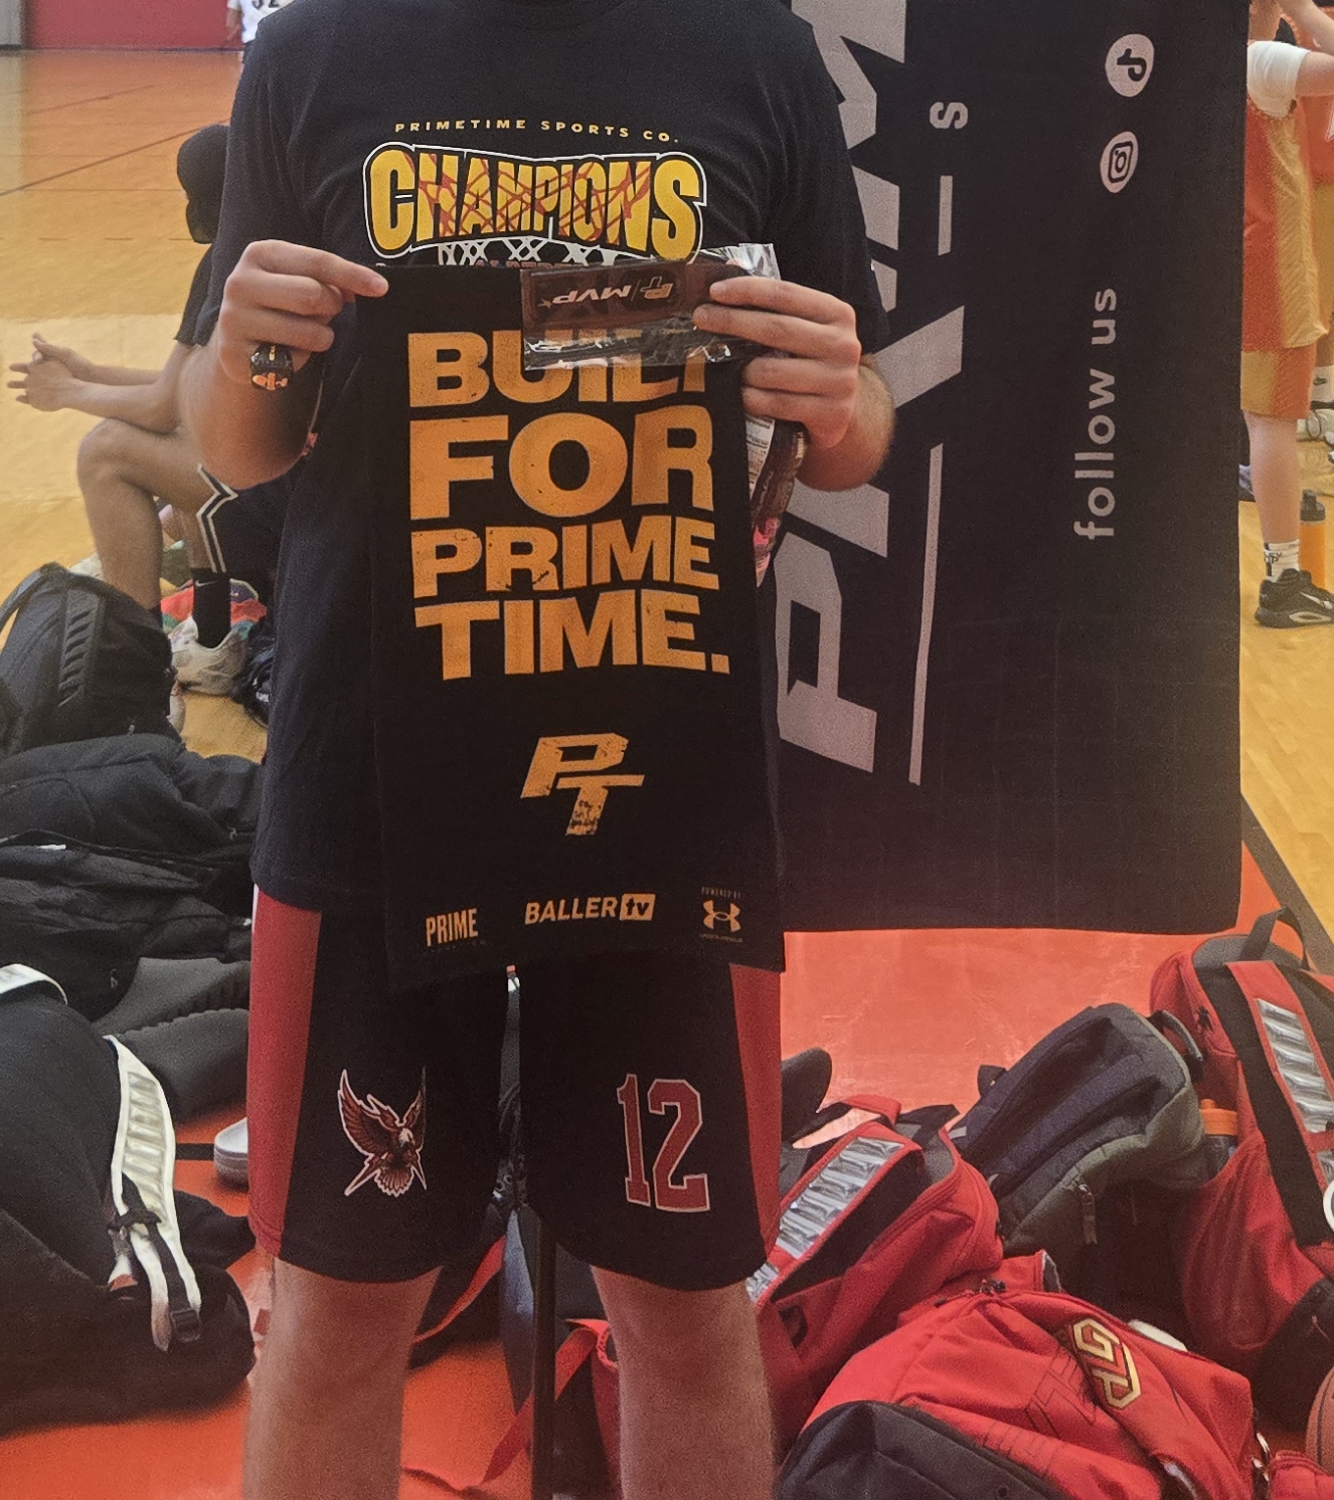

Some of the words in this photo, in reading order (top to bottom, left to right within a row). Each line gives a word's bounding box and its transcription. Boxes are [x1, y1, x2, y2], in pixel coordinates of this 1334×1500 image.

[395, 119, 526, 133] PRIMETIME
[540, 120, 629, 138] SPORTS
[642, 130, 679, 143] CO.
[368, 148, 702, 261] CHAMPIONS
[552, 285, 631, 305] MVP
[1091, 287, 1117, 345] us
[410, 405, 714, 520] FOR
[1073, 367, 1116, 541] follow
[411, 515, 720, 598] PRIME
[415, 588, 731, 680] TIME.
[426, 908, 478, 946] PRIME
[616, 1073, 711, 1212] 12
